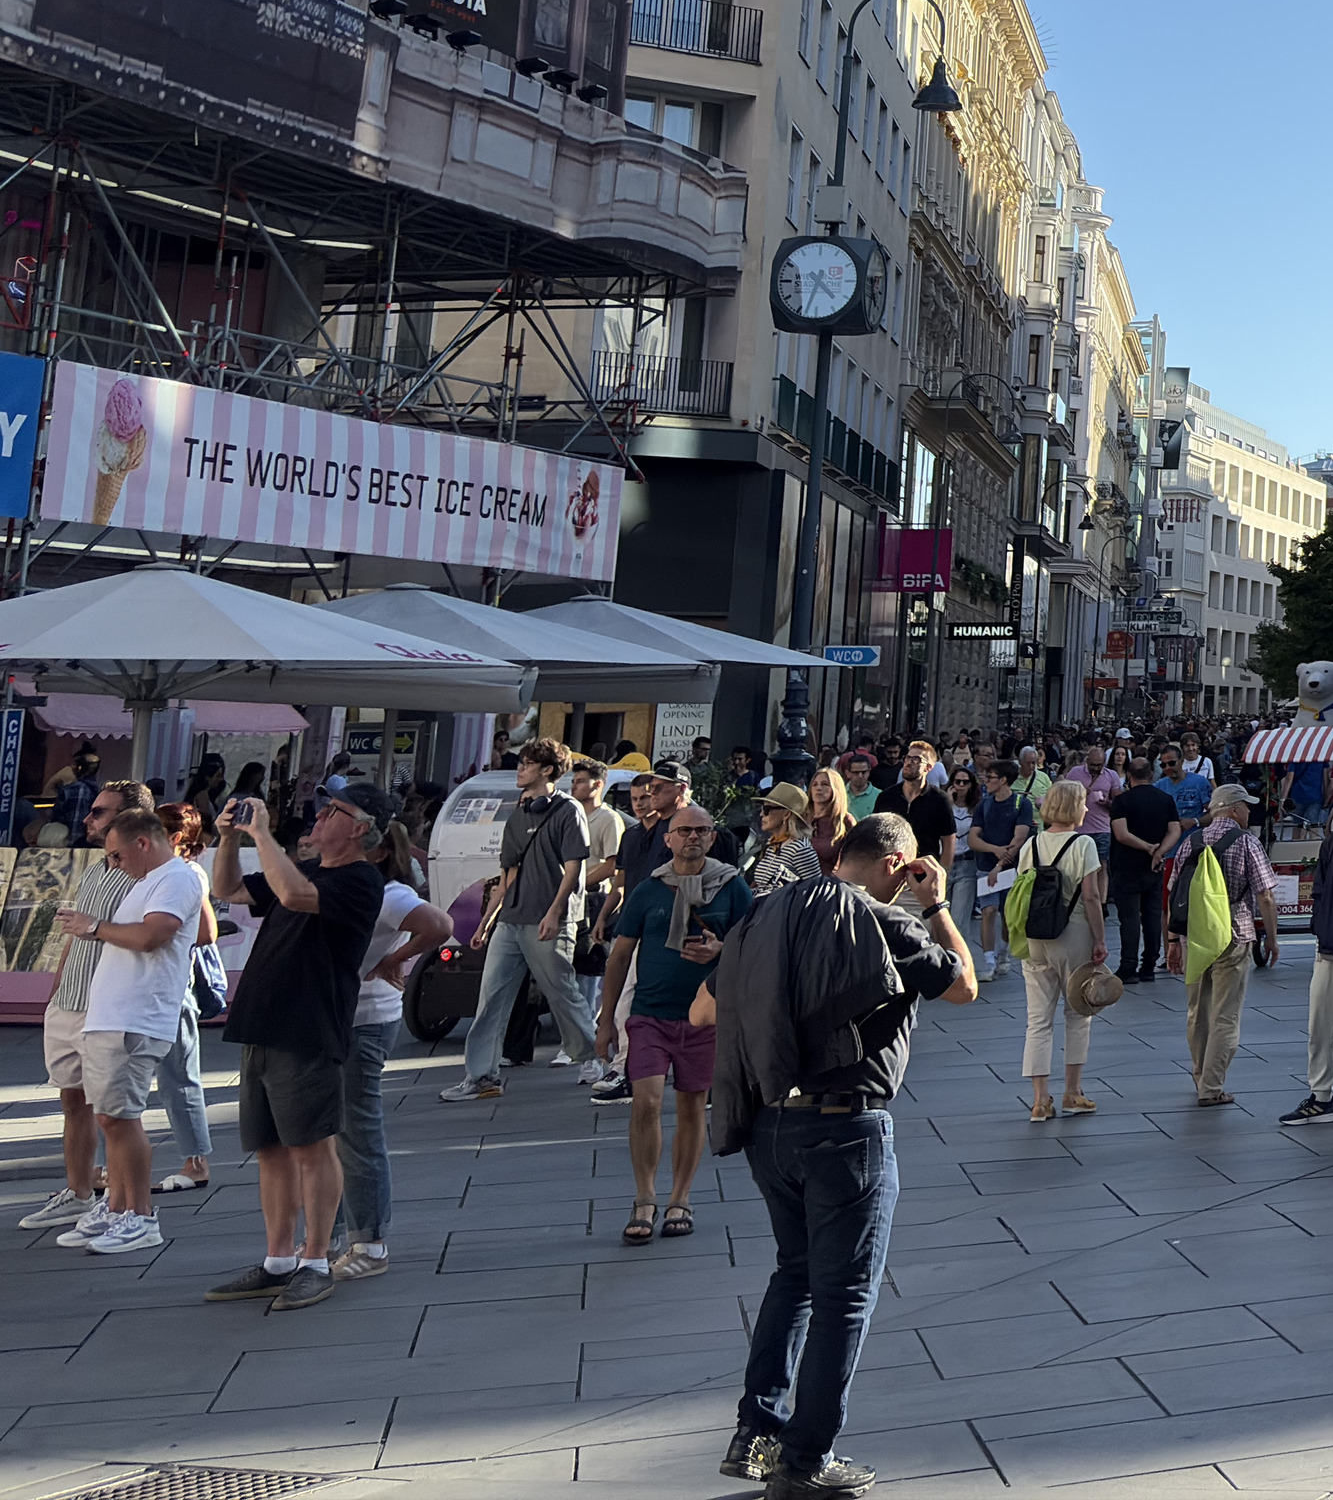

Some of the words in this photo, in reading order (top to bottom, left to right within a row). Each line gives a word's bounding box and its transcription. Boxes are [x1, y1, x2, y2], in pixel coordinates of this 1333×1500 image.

[0, 412, 24, 458] Y
[183, 437, 237, 484] THE
[246, 446, 362, 502] WORLD'S
[369, 467, 430, 510] BEST
[433, 477, 475, 515] ICE
[478, 484, 547, 528] CREAM
[903, 573, 945, 588] BIPA
[953, 626, 1014, 637] HUMANIC
[1130, 623, 1159, 632] KLIMT
[832, 650, 851, 662] WC
[663, 710, 705, 719] OPENING
[661, 725, 704, 737] LINDT
[350, 737, 369, 750] WC
[660, 740, 693, 748] FLAGSH
[659, 750, 692, 762] STOR
[0, 719, 19, 813] CHANGE
